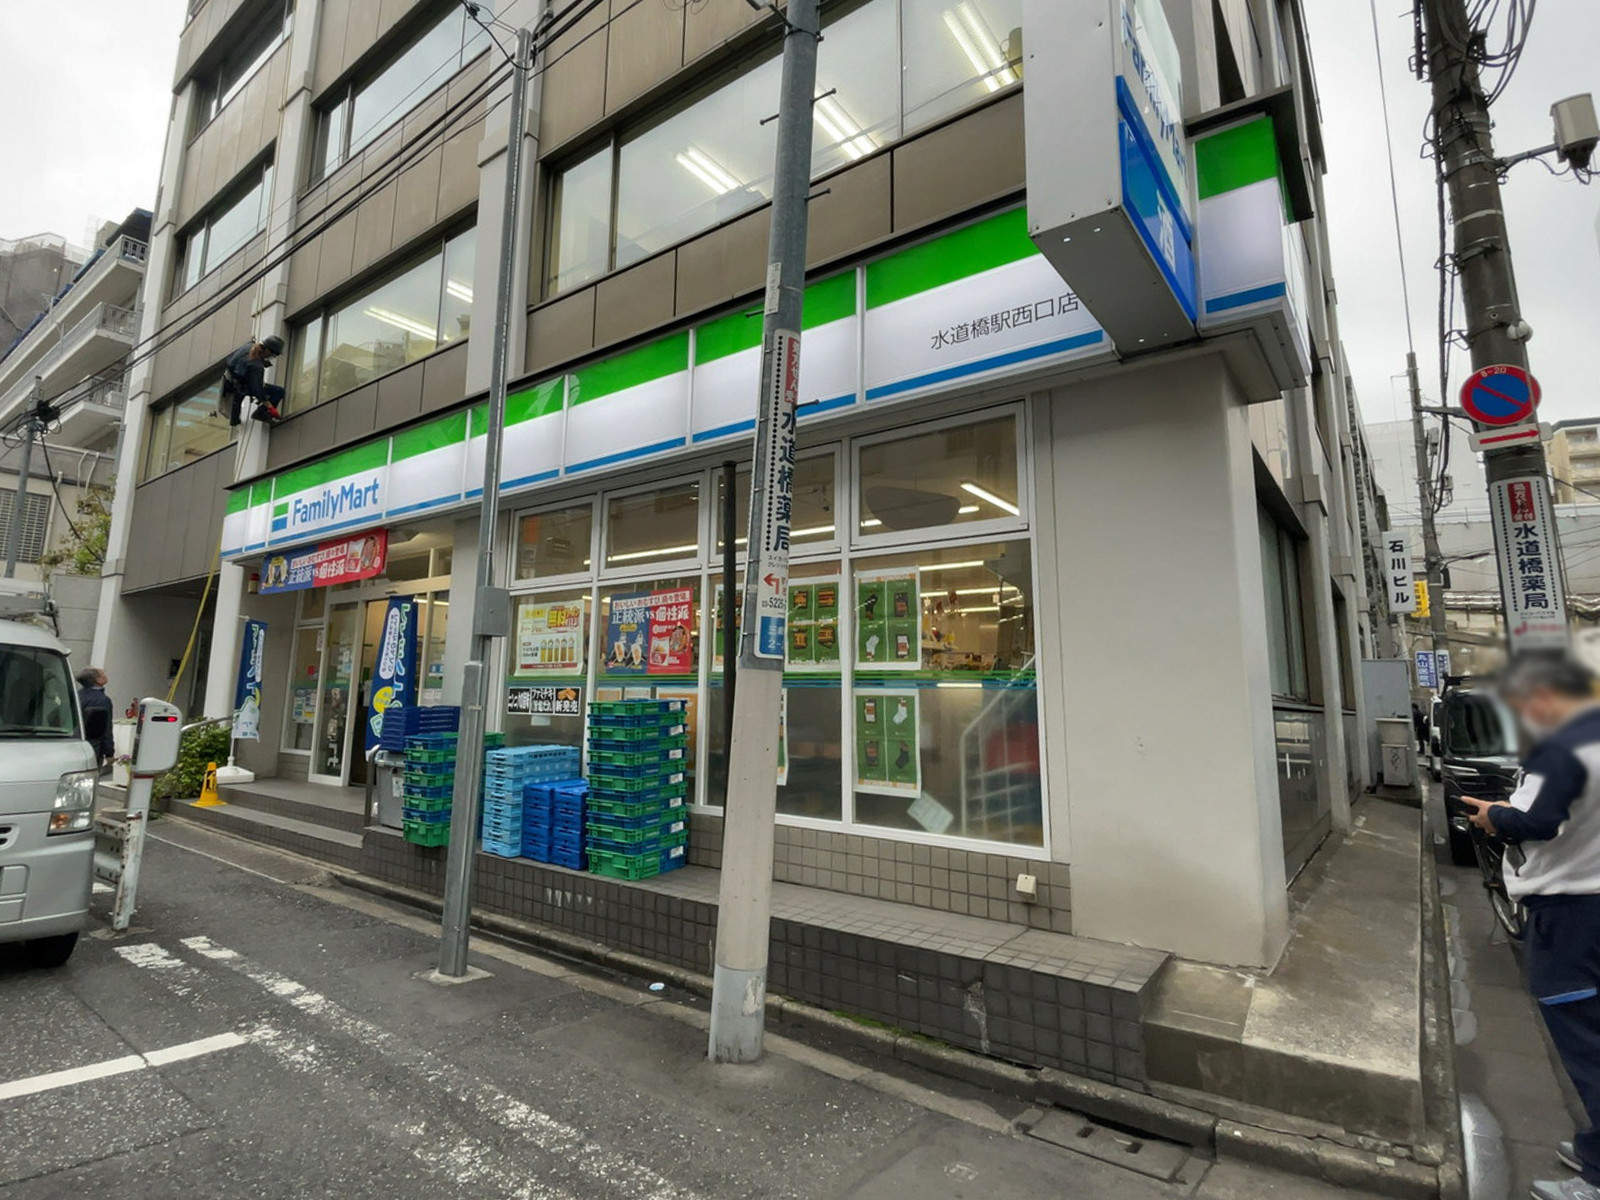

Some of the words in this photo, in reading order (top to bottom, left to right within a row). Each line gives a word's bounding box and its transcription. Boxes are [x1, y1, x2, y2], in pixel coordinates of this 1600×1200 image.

[930, 292, 1079, 350] 水道橋駅西口店
[1481, 367, 1507, 377] 8-20
[292, 477, 379, 526] FamilyMart
[1388, 539, 1410, 604] 石川ビル
[1513, 523, 1549, 609] 水道橋薬局
[611, 607, 645, 624] 正統派
[655, 604, 690, 621] 個性派
[556, 700, 578, 712] 新発売
